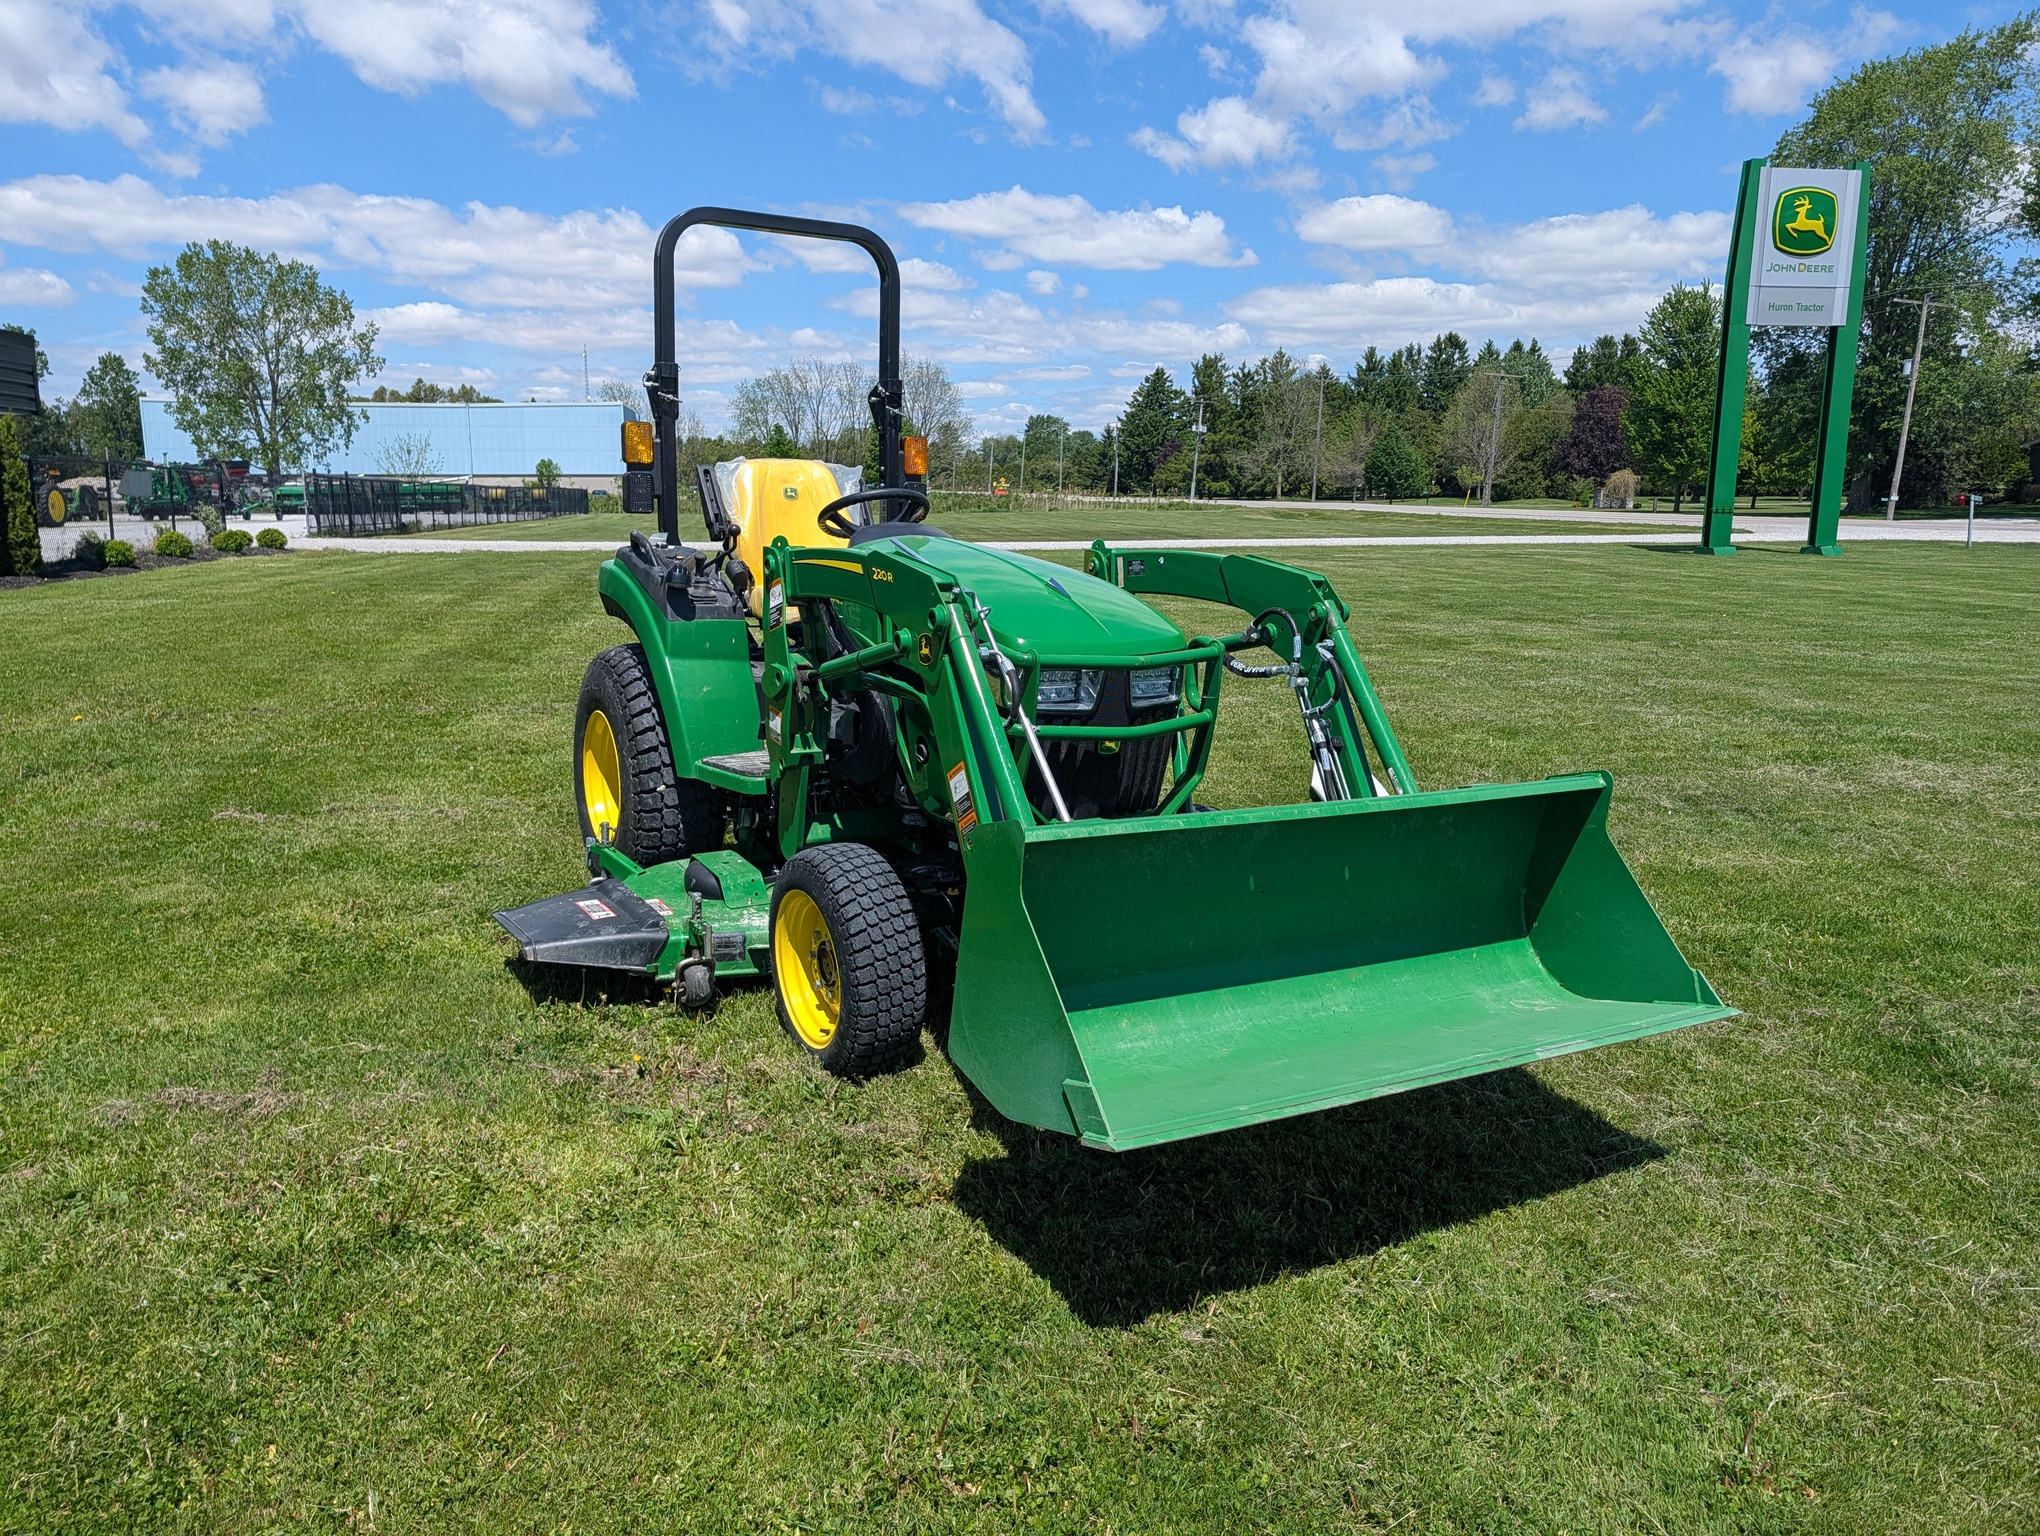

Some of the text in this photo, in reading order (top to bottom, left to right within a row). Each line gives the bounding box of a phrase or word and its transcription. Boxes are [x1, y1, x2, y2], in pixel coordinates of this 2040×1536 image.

[1766, 262, 1835, 273] JOHN DEERE
[1768, 302, 1825, 312] Huron Tractor
